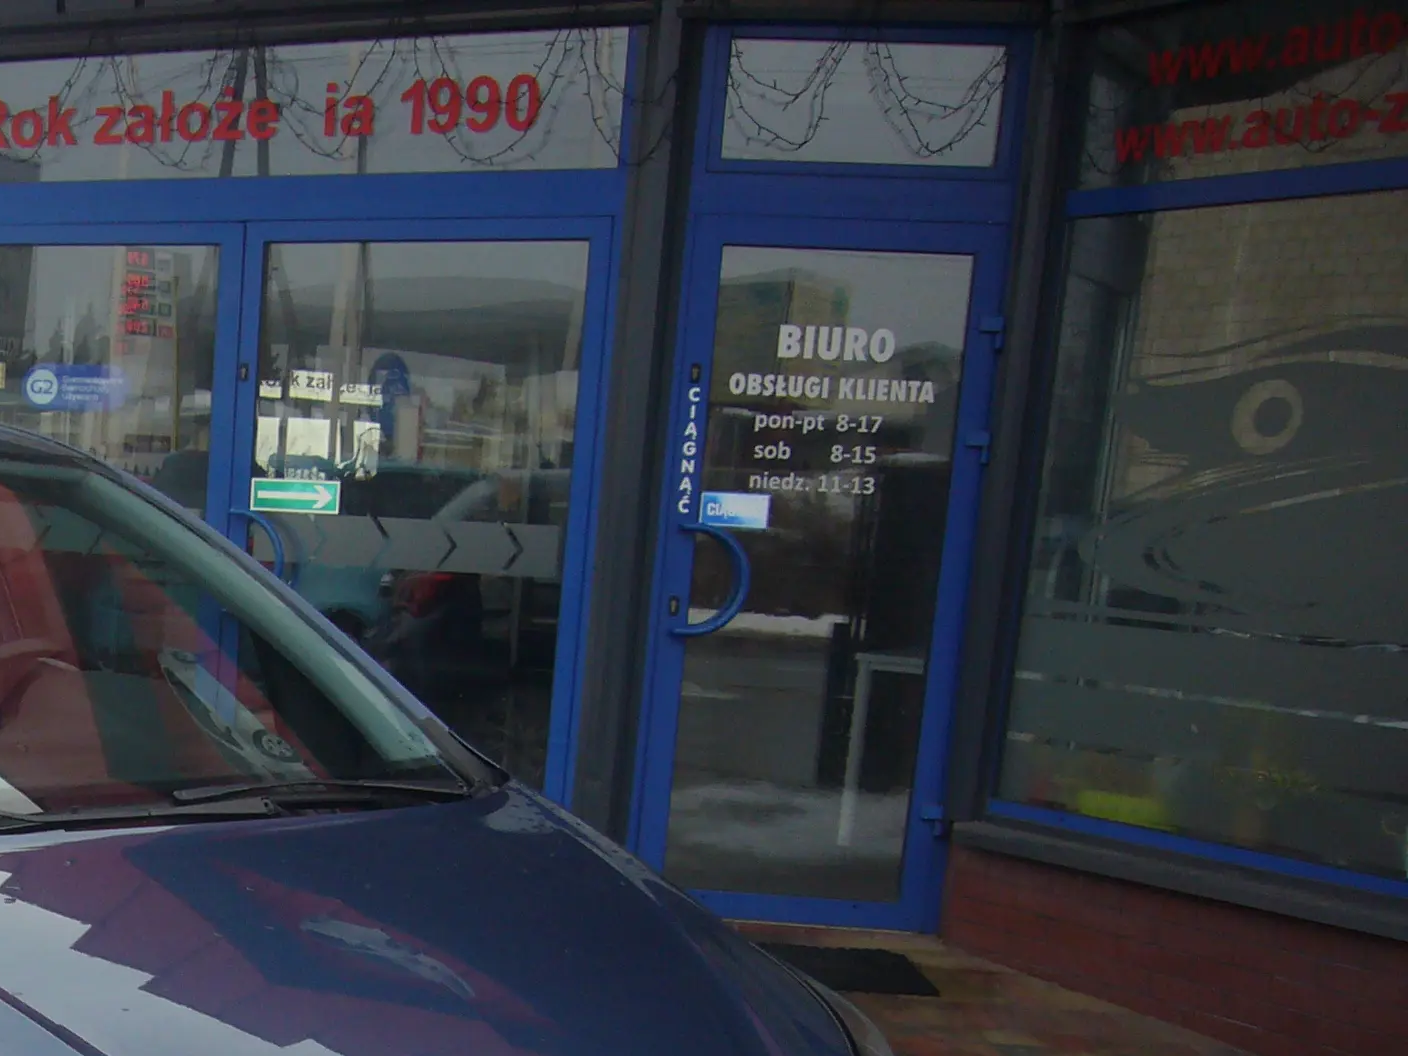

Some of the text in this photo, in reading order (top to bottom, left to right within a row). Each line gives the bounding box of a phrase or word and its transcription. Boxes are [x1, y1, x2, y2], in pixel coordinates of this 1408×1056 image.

[400, 73, 542, 135] 1990
[777, 324, 895, 362] BIURO
[31, 379, 53, 395] G2
[729, 373, 935, 403] OBSŁUGI KLIENTA
[753, 413, 883, 434] pon-pt 8-17
[678, 387, 701, 514] CIĄGNĄĆ
[753, 442, 877, 464] sob 8-15
[749, 472, 875, 495] niedz. 11-13
